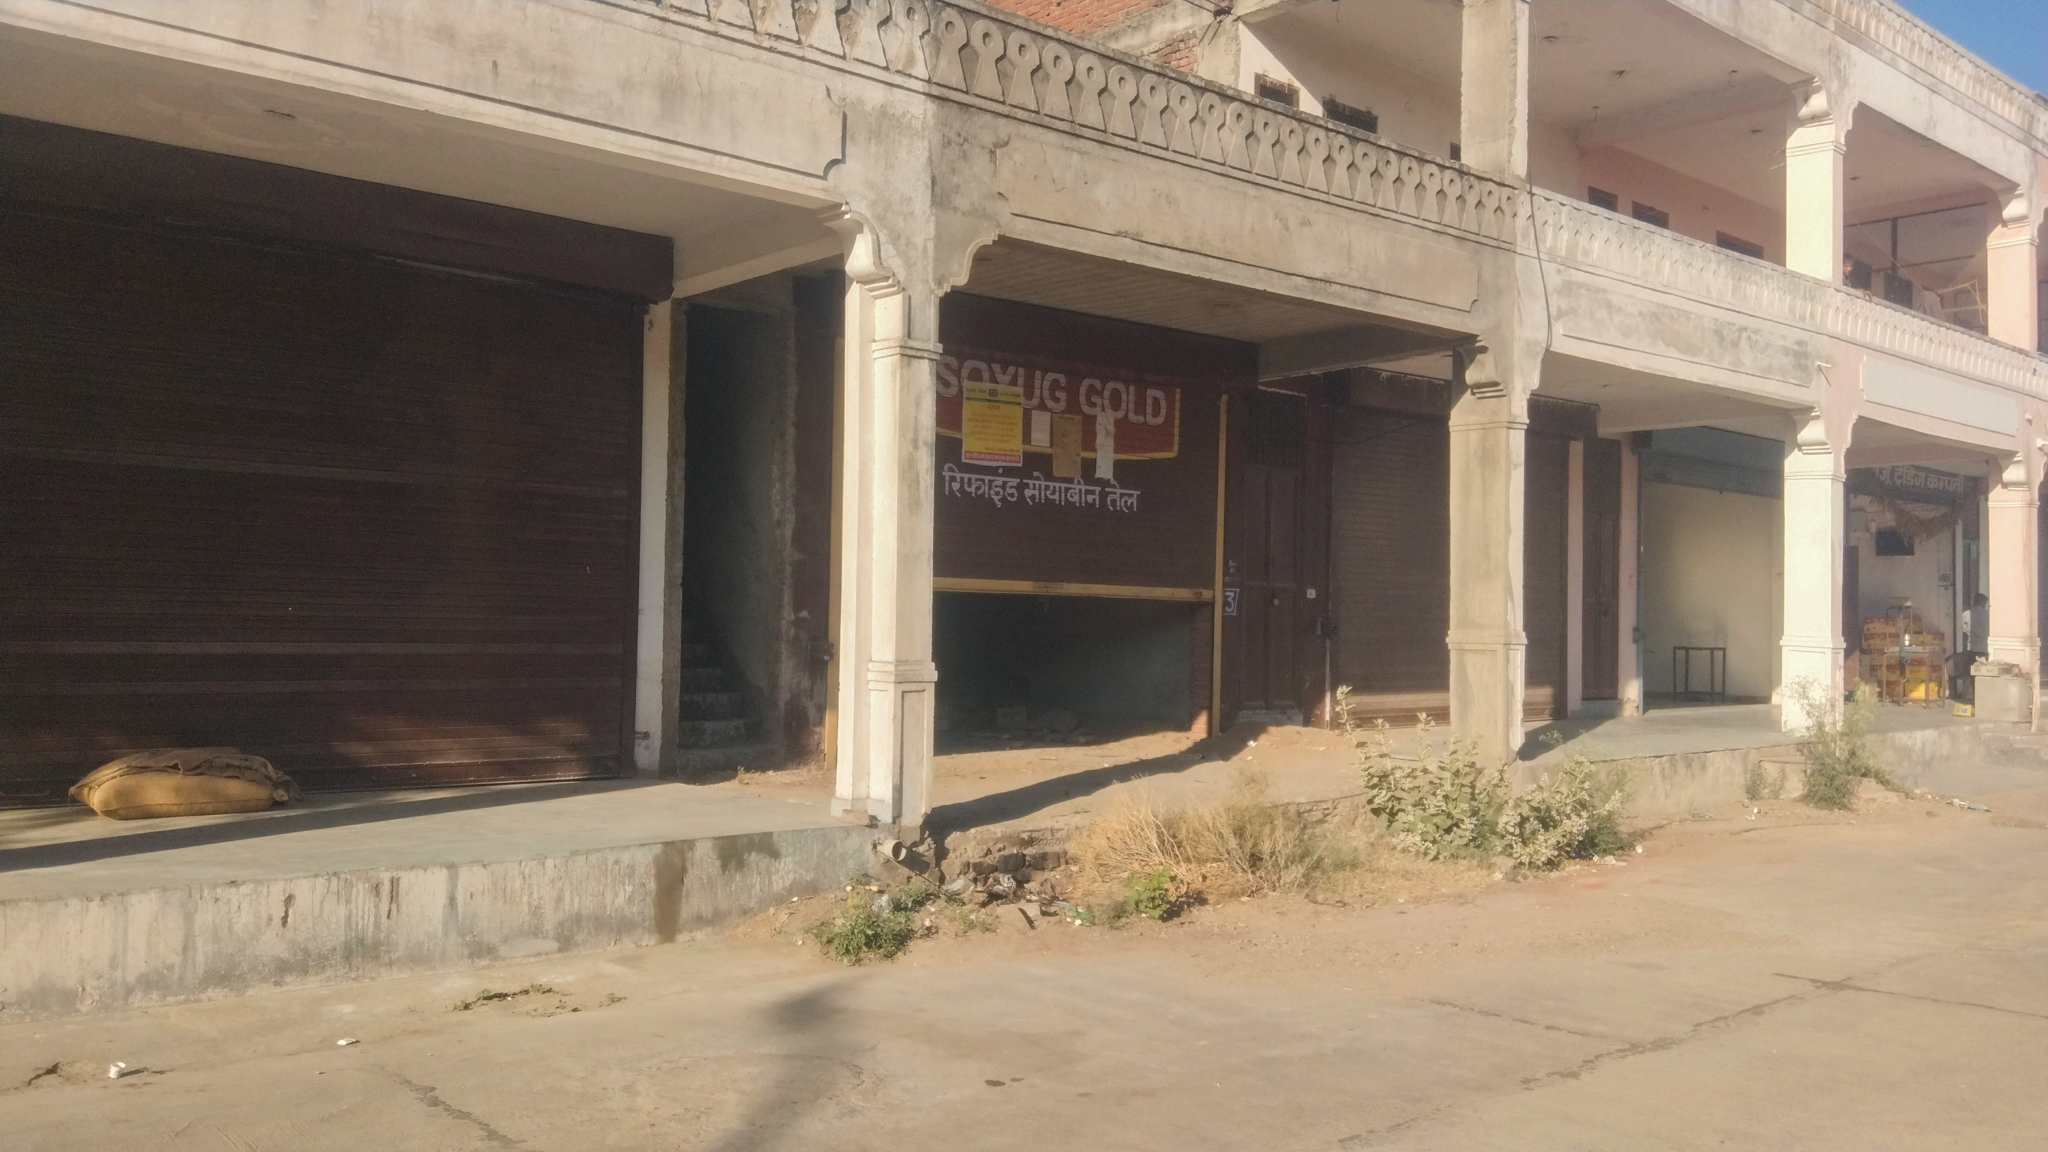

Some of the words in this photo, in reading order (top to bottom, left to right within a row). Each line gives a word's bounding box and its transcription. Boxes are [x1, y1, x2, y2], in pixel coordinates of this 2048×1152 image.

[1079, 377, 1167, 427] GOLD
[942, 463, 1021, 508] रिफाइंड
[1023, 471, 1101, 508] सोयाबीन
[1105, 478, 1141, 513] तेल
[1224, 591, 1235, 613] 3
